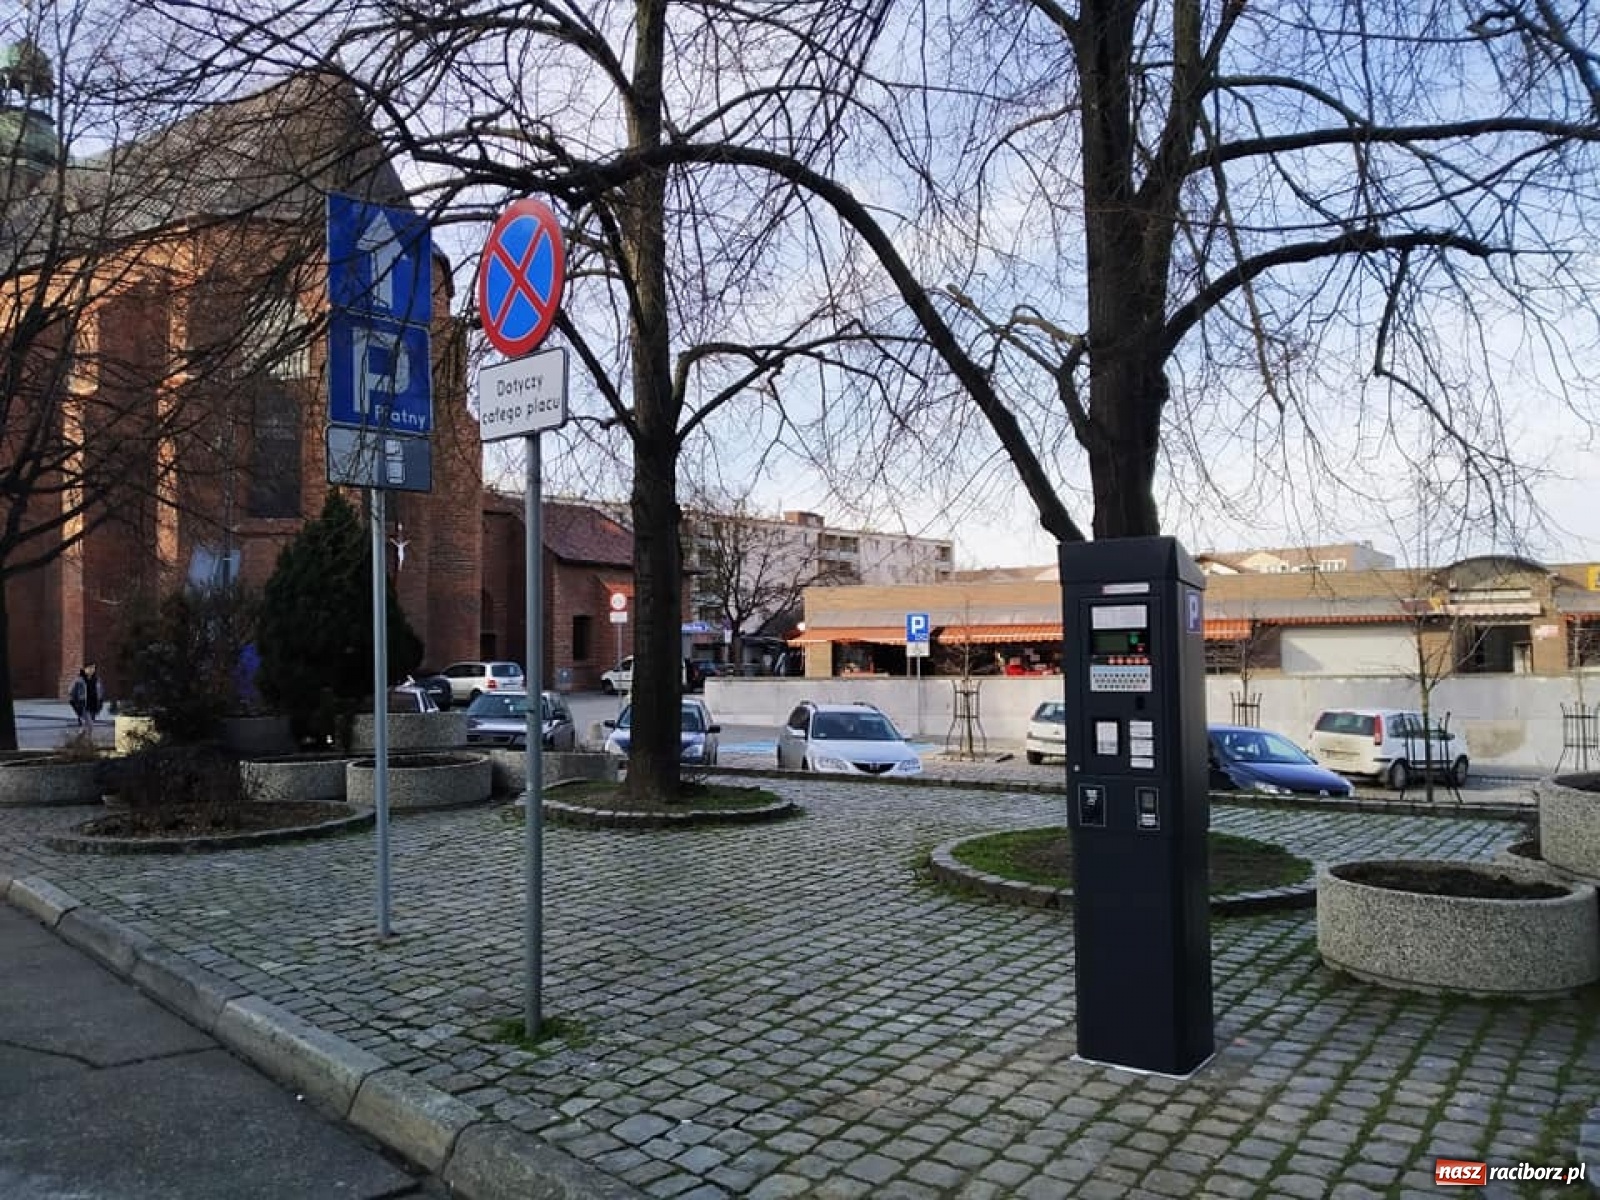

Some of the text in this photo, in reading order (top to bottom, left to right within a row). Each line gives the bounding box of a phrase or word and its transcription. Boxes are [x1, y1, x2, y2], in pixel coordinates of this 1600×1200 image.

[352, 327, 410, 414] P
[496, 375, 544, 397] Dotyczy
[374, 404, 426, 429] Patny
[482, 398, 560, 425] całego placu
[1188, 594, 1199, 629] P
[911, 616, 925, 634] P
